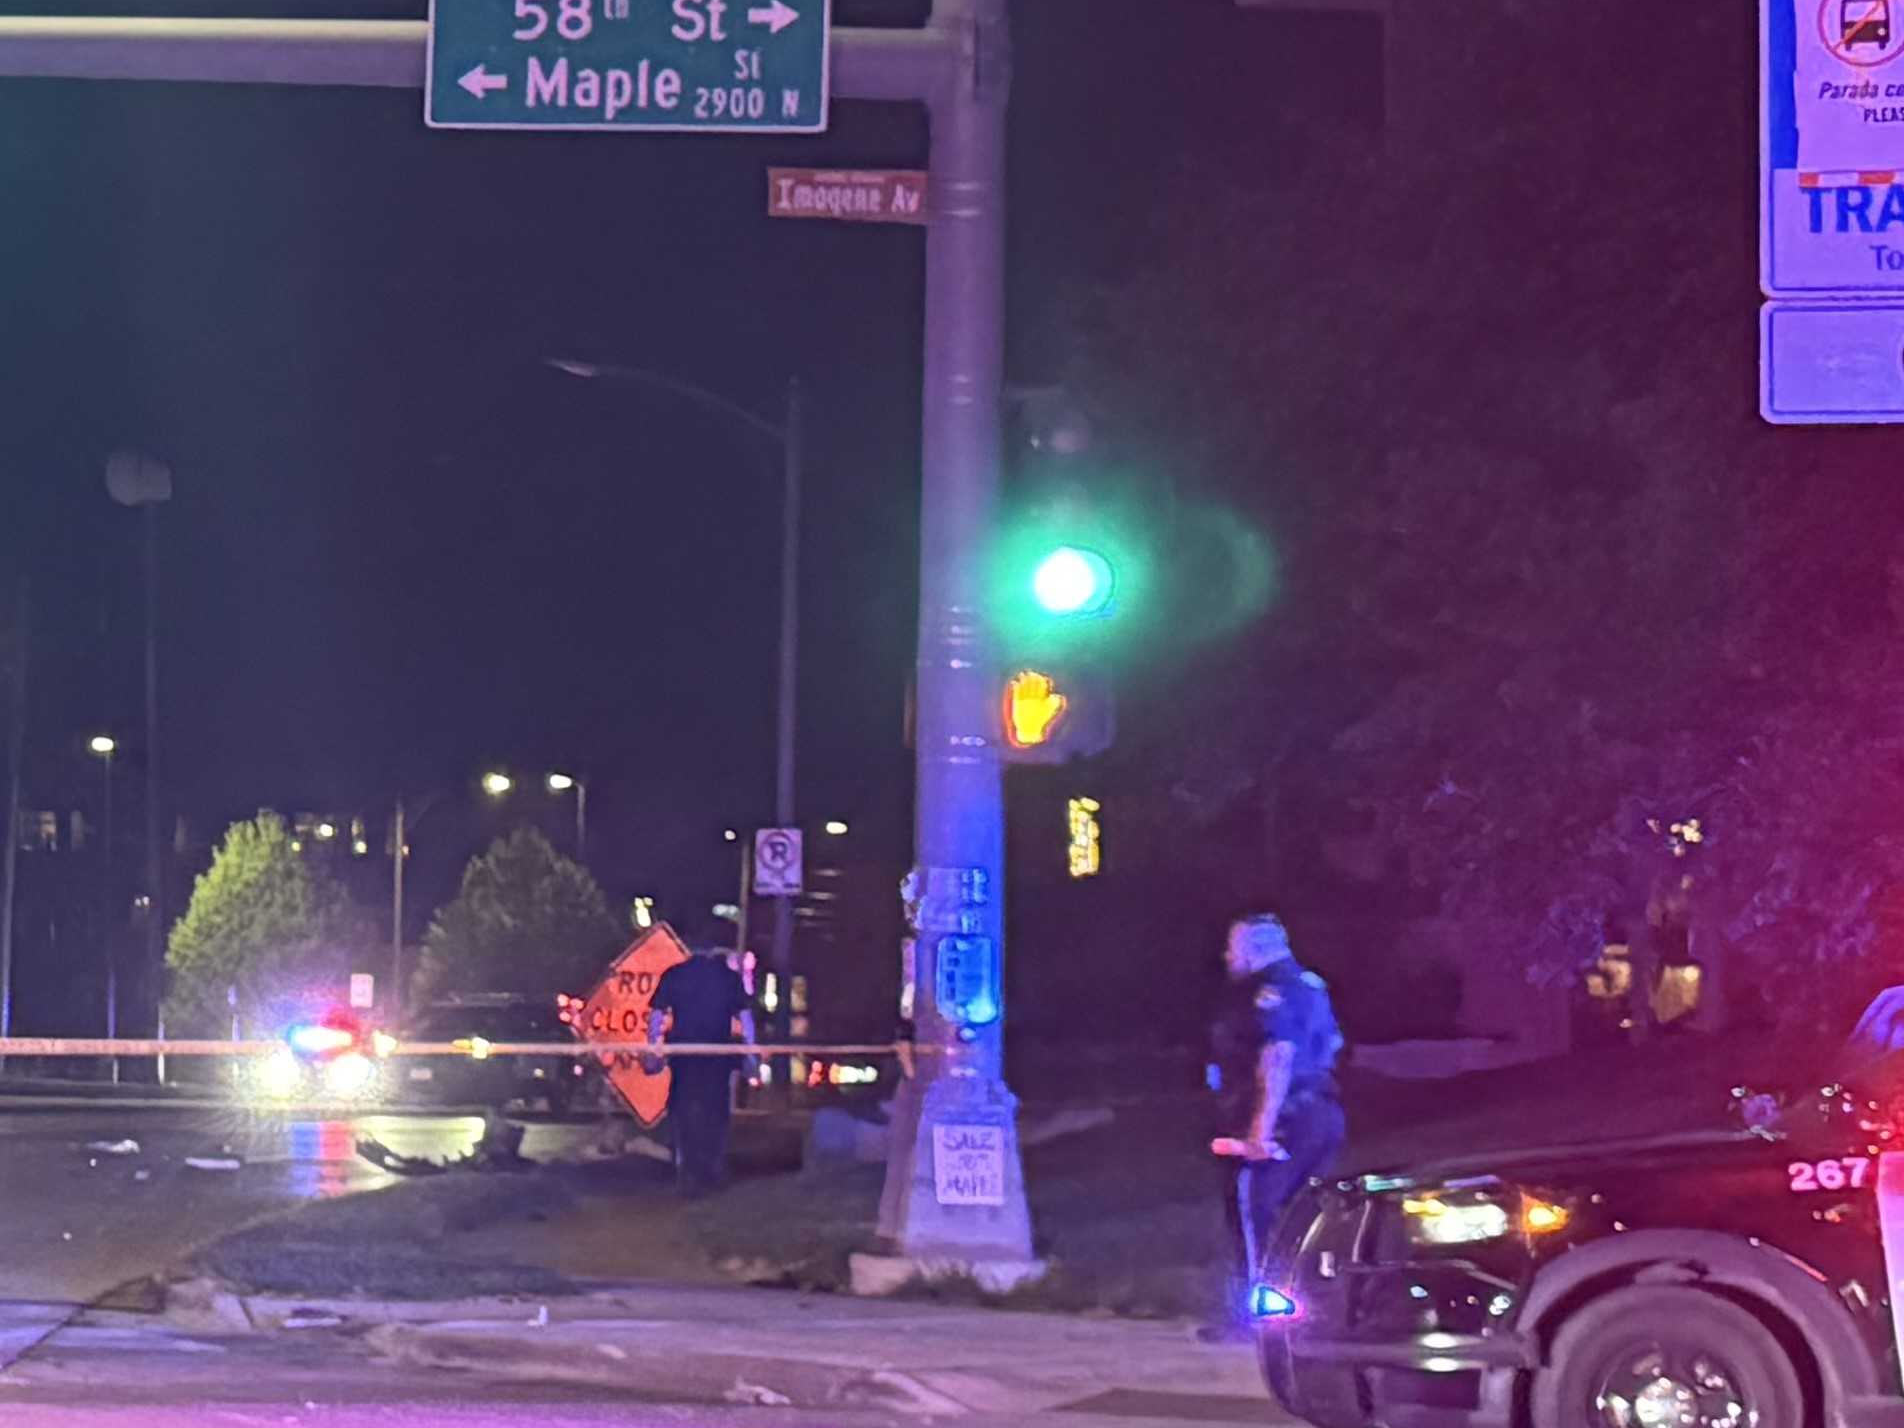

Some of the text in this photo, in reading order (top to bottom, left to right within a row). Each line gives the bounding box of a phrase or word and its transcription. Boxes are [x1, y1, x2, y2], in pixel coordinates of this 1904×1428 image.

[525, 48, 763, 120] Maple St
[1818, 81, 1879, 100] Parada
[694, 86, 800, 119] 2900 N
[776, 177, 922, 217] Imogene Av
[617, 970, 653, 995] RO
[592, 1006, 651, 1033] CLOS
[1787, 1156, 1871, 1192] 267
